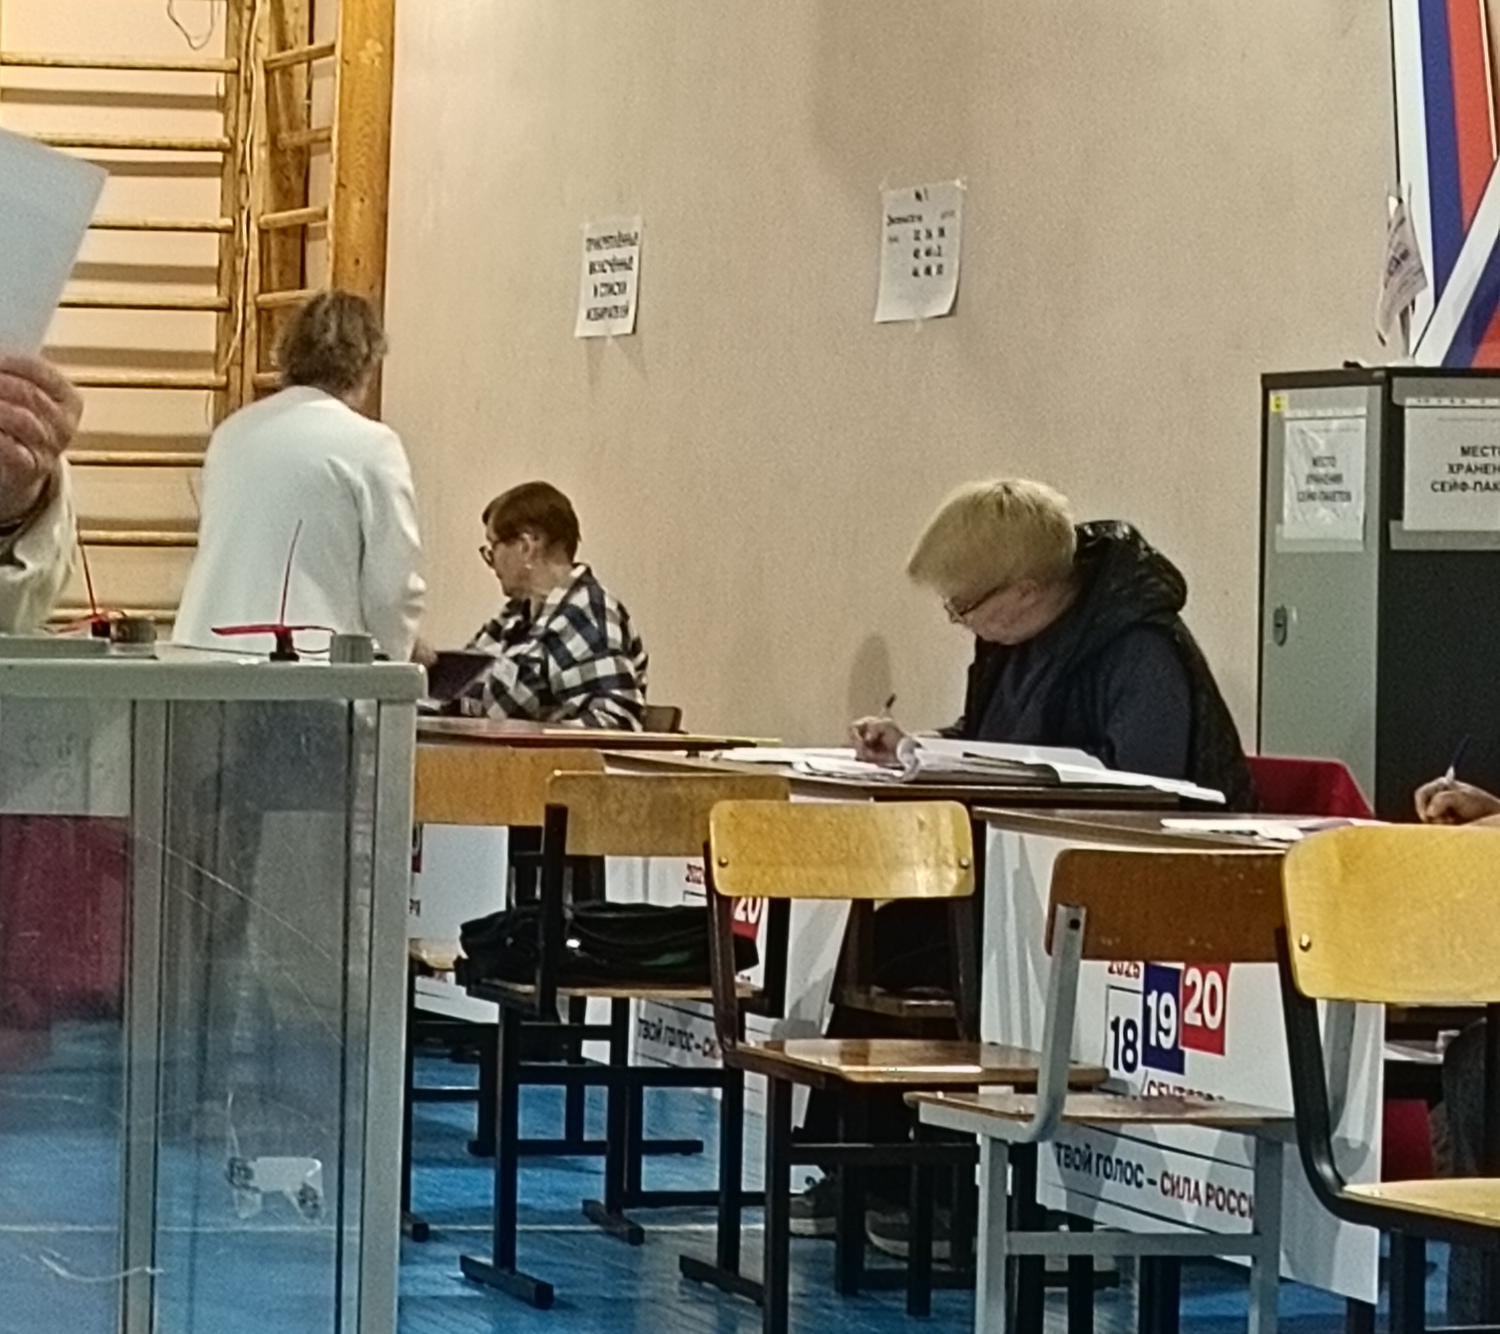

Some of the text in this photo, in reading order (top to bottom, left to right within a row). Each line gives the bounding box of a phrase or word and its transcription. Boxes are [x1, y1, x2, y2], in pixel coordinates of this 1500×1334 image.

[1460, 446, 1500, 458] МЕСТ
[1110, 967, 1224, 1074] 18 19 20
[1055, 1142, 1093, 1175] ТВОЙ
[1095, 1153, 1145, 1189] ГОЛОС
[1160, 1170, 1203, 1207] СИЛА
